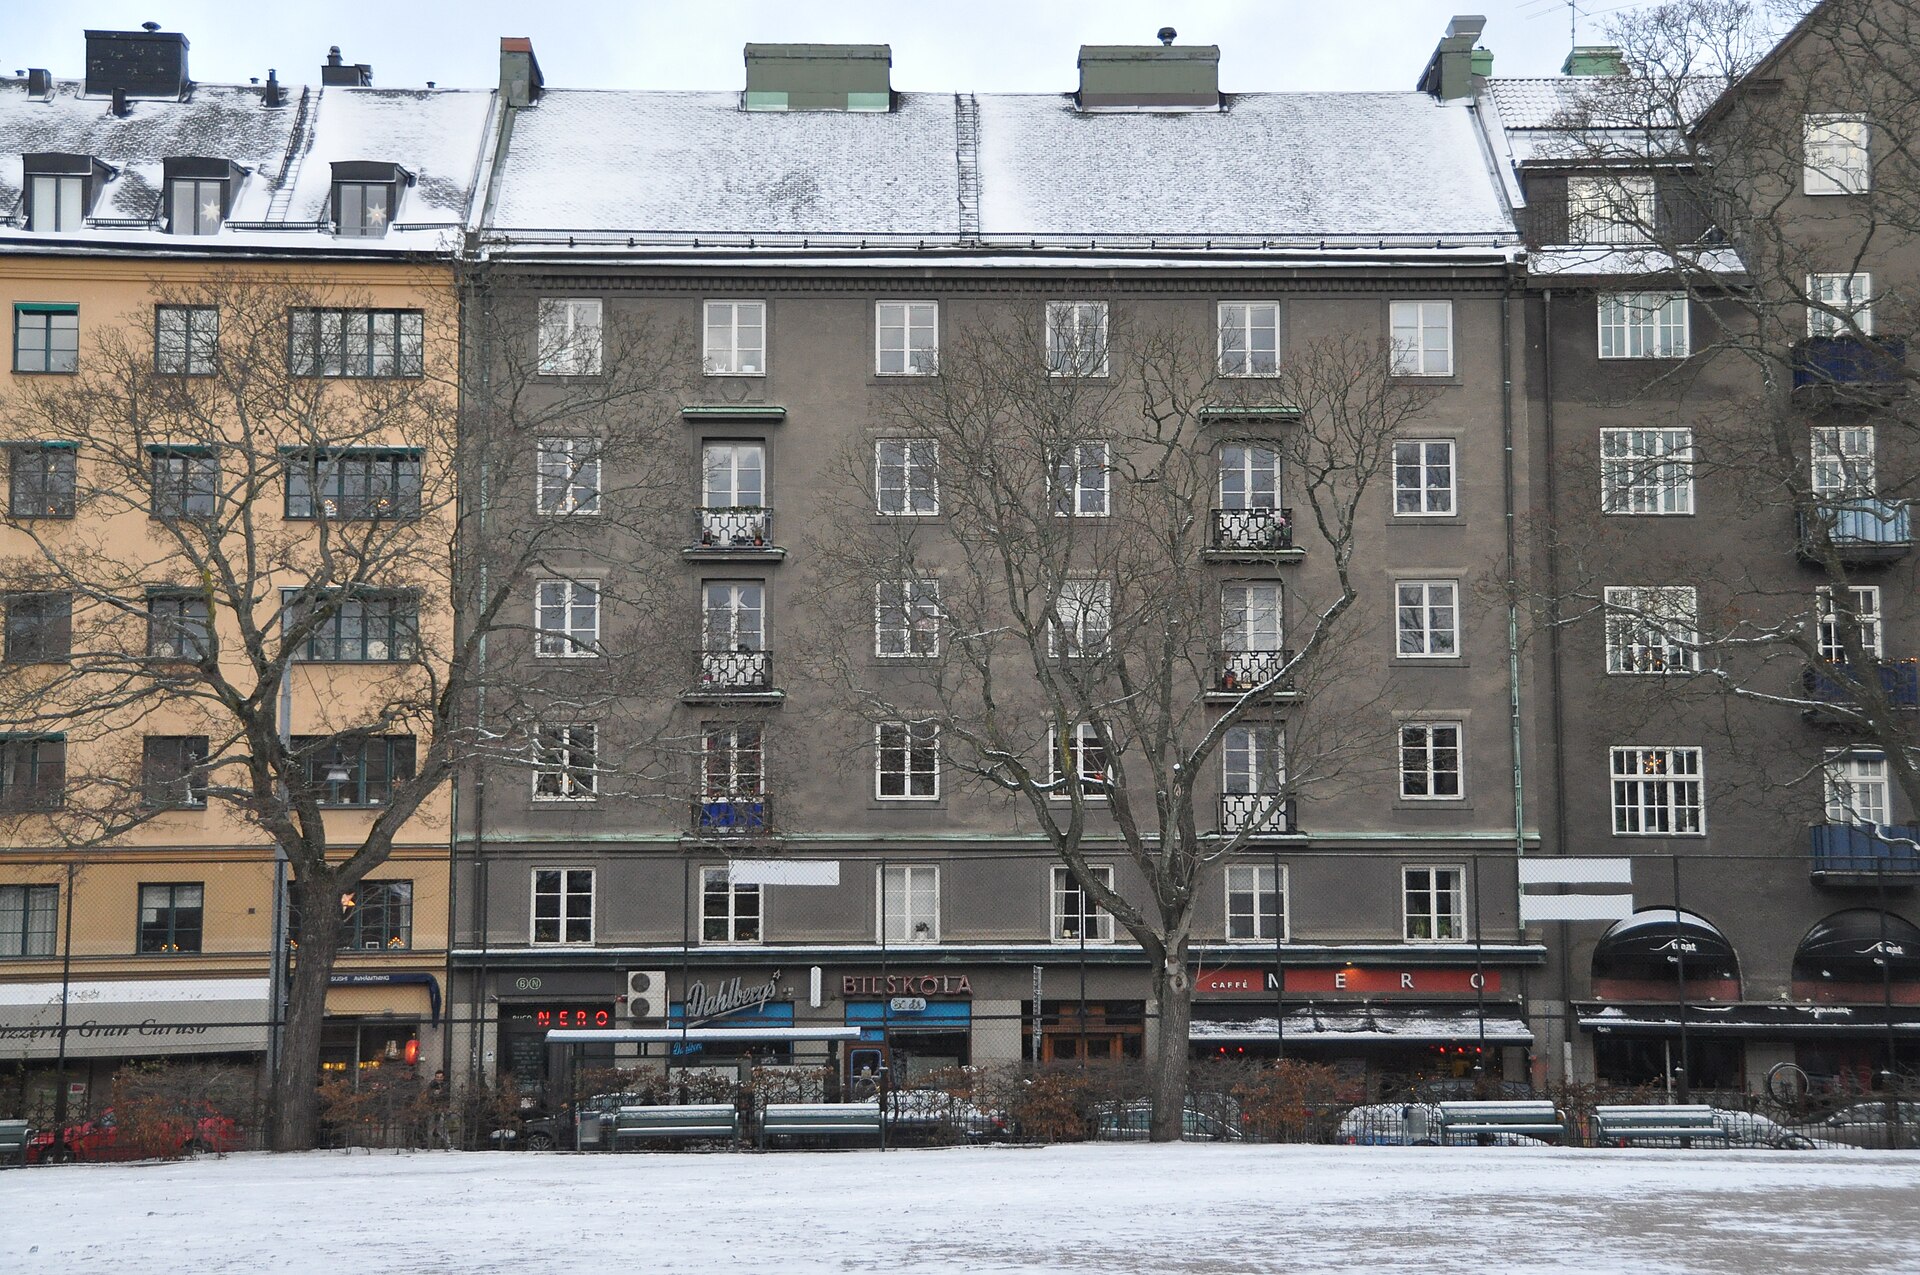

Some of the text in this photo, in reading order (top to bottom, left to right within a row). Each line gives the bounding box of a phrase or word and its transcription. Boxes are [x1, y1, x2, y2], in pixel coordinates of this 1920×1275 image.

[843, 975, 973, 996] BILSKOLA
[1268, 973, 1484, 988] NERO
[538, 1010, 608, 1026] NERO
[0, 1018, 208, 1040] izzeria Gran Caruso
